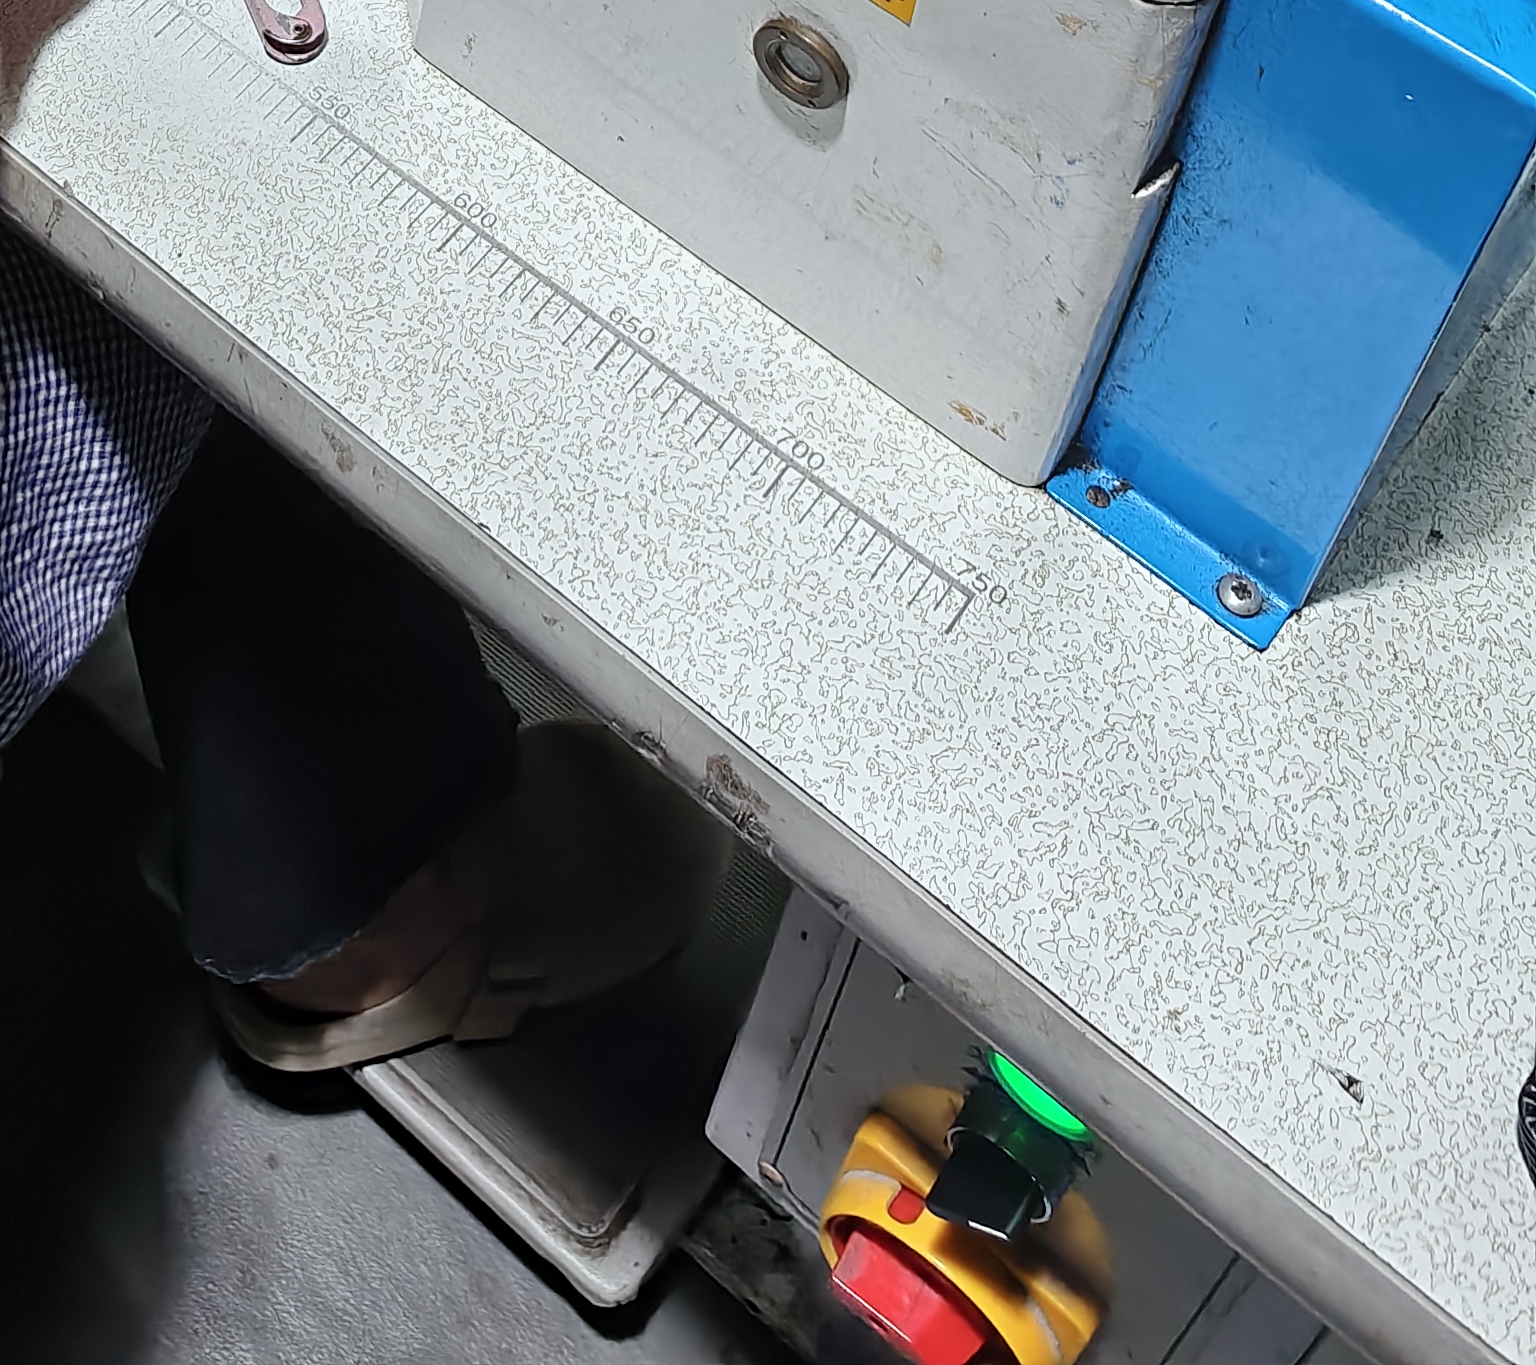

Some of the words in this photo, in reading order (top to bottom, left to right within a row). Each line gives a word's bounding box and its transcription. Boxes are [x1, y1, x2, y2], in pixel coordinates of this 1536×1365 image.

[308, 85, 350, 119] 550
[454, 193, 497, 228] 600
[610, 306, 655, 344] 650
[777, 427, 825, 469] 700
[950, 560, 1007, 604] 750
